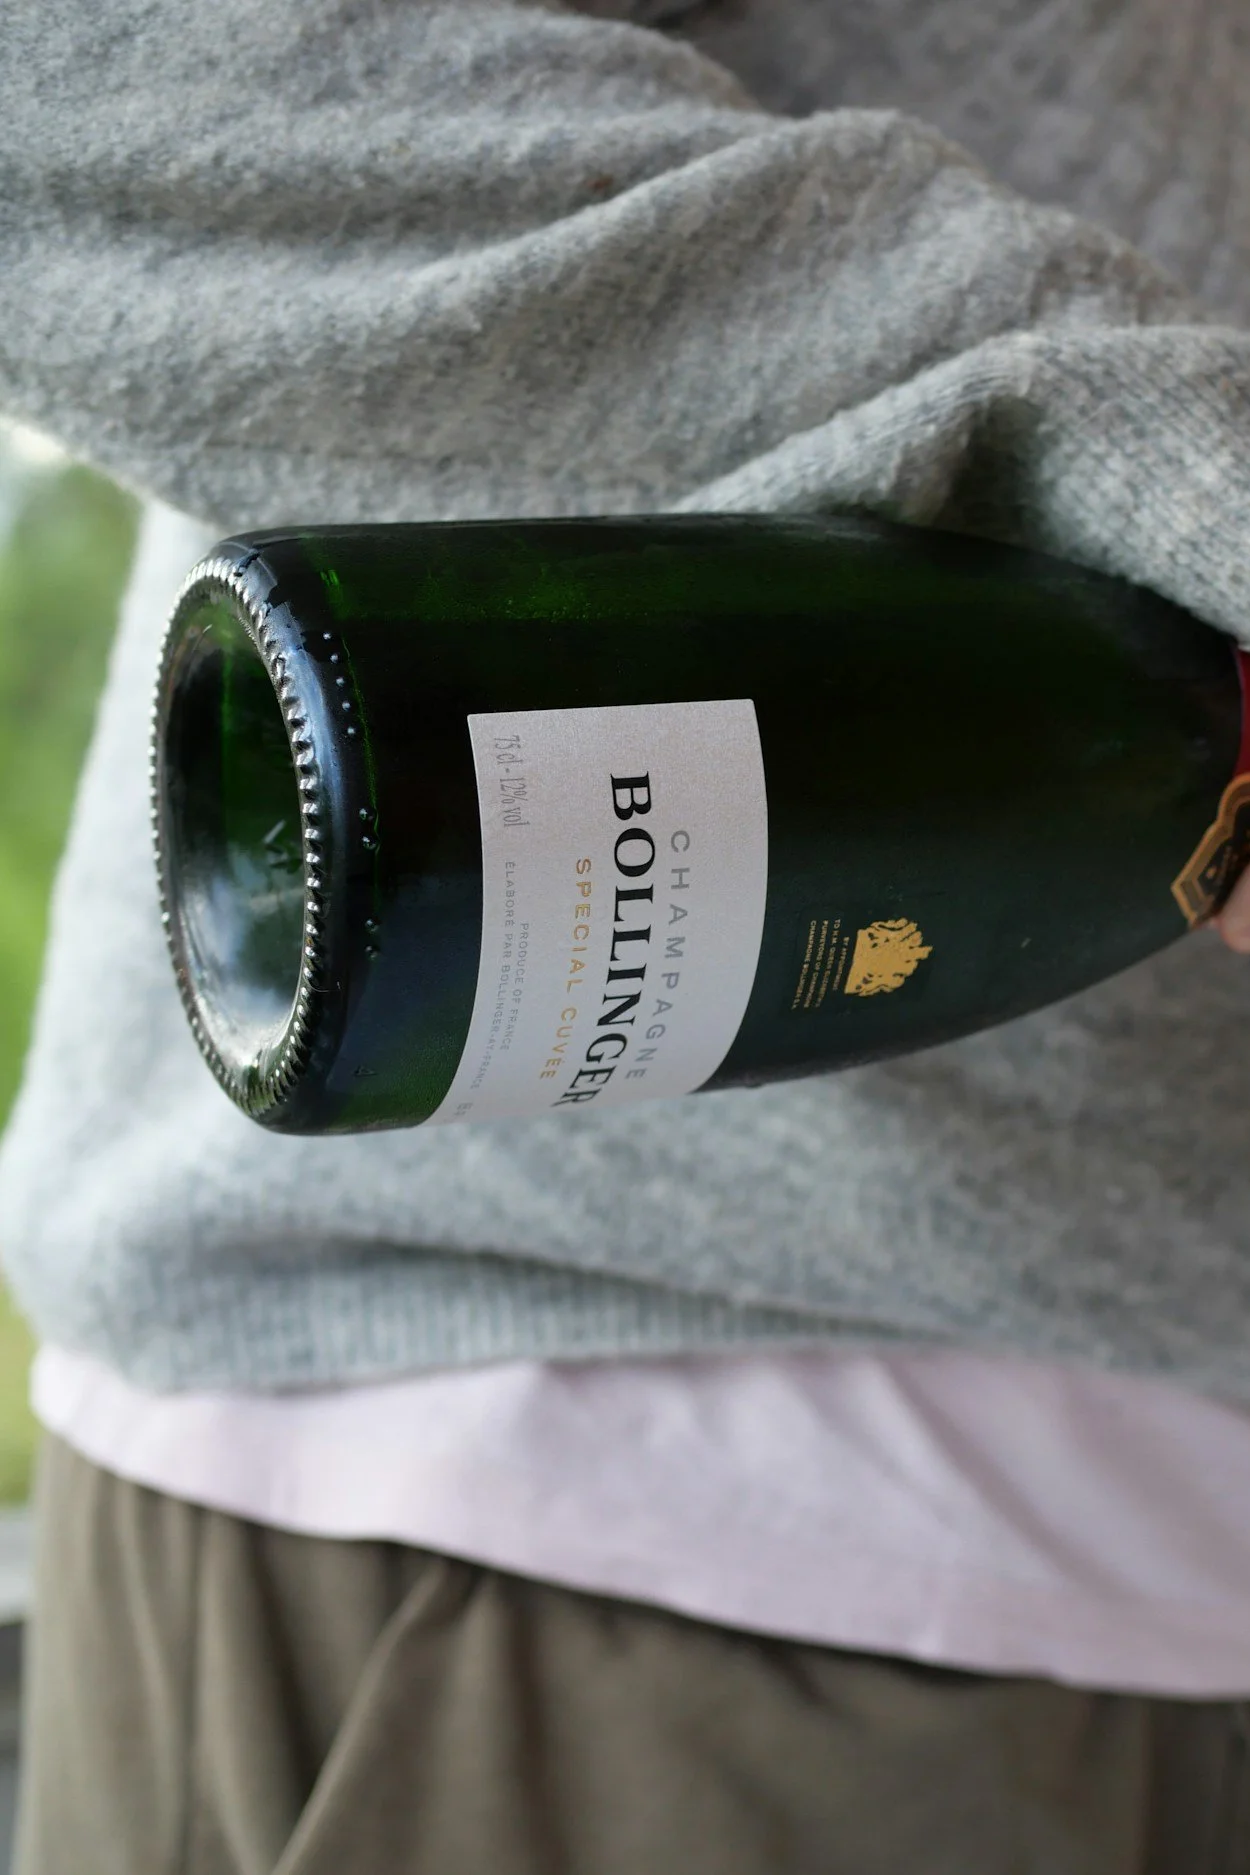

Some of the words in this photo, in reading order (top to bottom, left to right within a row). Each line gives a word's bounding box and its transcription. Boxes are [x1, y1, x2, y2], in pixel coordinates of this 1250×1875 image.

[494, 735, 521, 750] 75
[500, 777, 529, 804] 12%
[503, 807, 531, 828] vol
[505, 861, 516, 927] ÉLABORÉ
[550, 771, 655, 1108] BOLLINGER
[566, 856, 592, 993] SPECIAL
[804, 920, 817, 962] CHAMPAGNE
[816, 920, 828, 961] PURVEYORS
[834, 919, 841, 929] TO
[502, 933, 514, 959] PAR
[514, 922, 530, 985] PRODUCE
[624, 830, 690, 1079] CHAMPAGNE
[511, 988, 523, 1004] OF
[500, 1008, 519, 1051] FRANCE
[539, 1007, 577, 1079] CUVÉE
